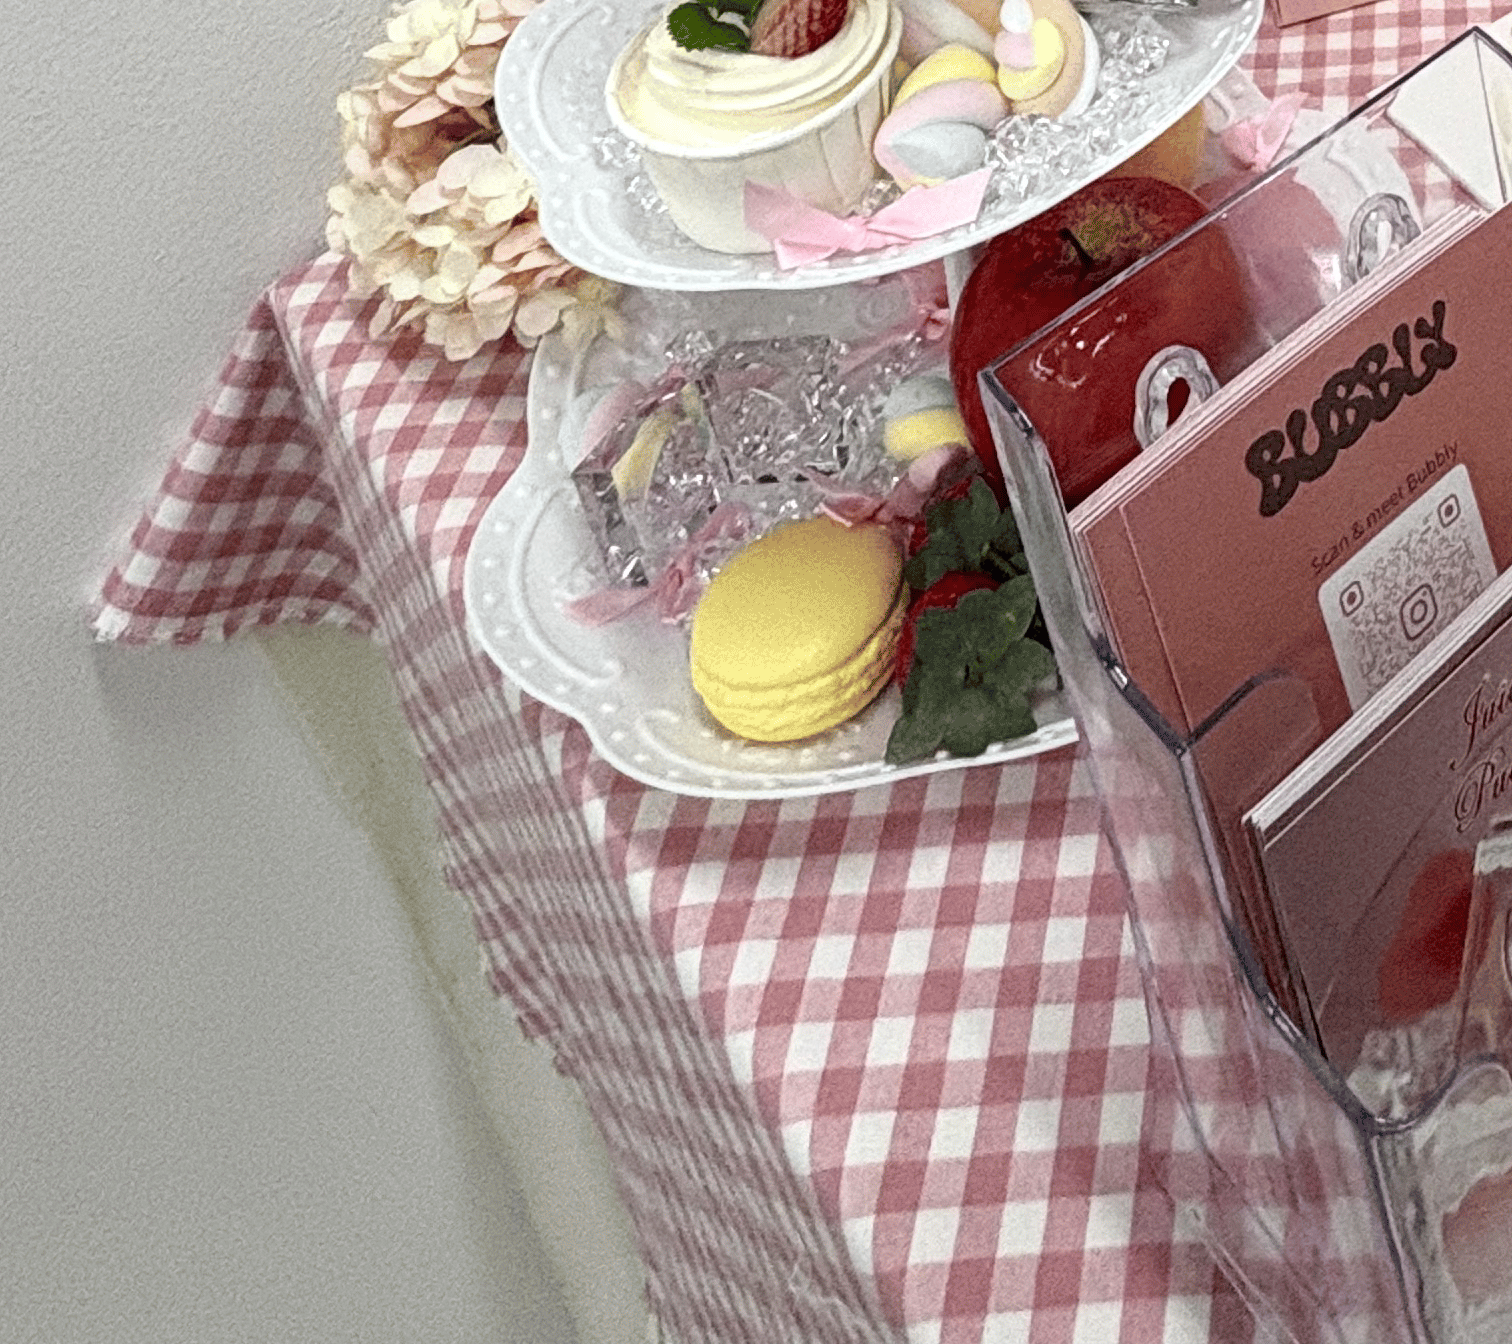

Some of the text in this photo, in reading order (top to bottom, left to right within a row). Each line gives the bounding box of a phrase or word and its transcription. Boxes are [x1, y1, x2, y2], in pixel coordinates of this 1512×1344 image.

[1310, 440, 1460, 575] Scan & meet Bubbly
